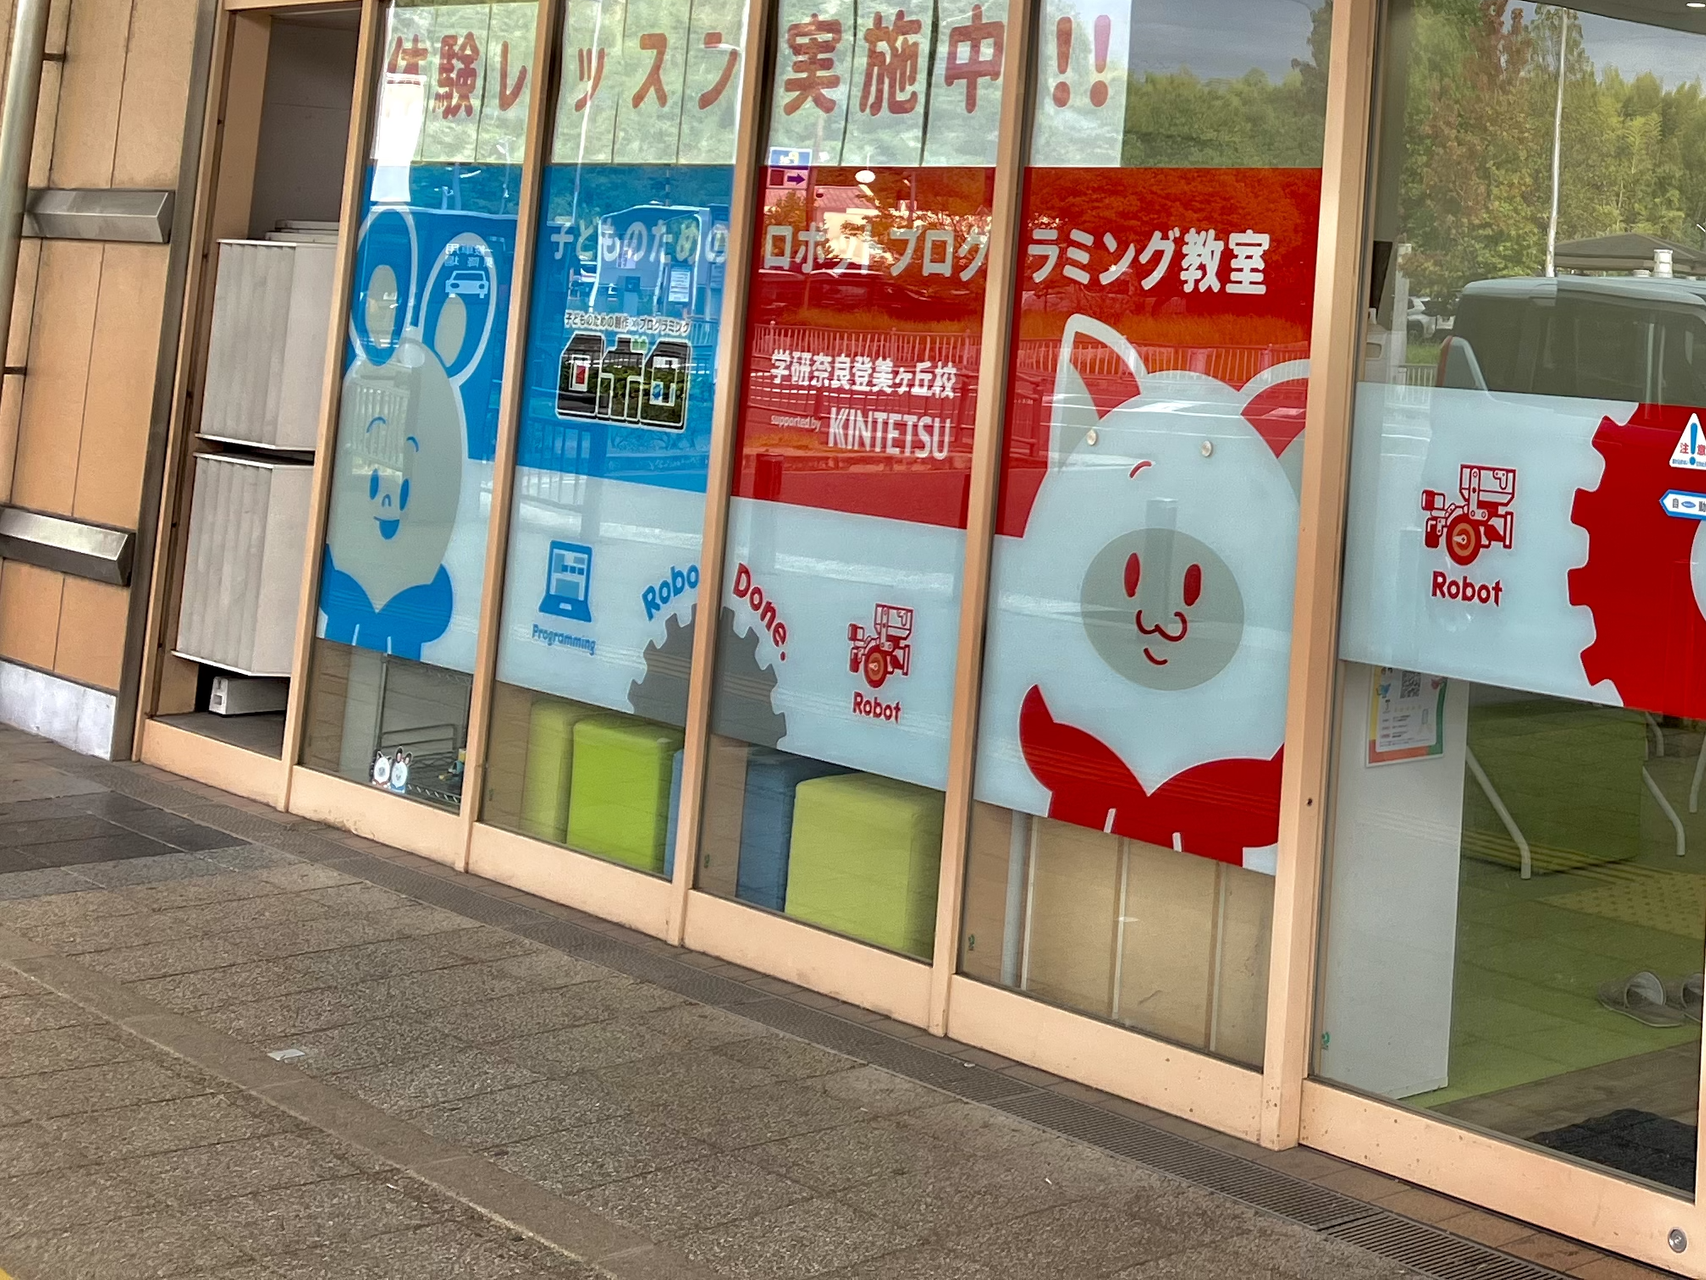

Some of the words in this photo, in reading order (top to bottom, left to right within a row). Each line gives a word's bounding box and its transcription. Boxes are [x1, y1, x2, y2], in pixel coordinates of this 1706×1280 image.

[551, 219, 728, 262] 子どものための
[564, 312, 629, 330] 子どものための制作
[639, 317, 691, 335] プログラミング
[770, 414, 809, 430] supported
[810, 417, 822, 433] by
[827, 407, 951, 460] KINTETSU
[1431, 570, 1503, 607] Robot
[641, 564, 699, 621] Robo
[732, 562, 788, 662] Done.
[531, 623, 596, 657] Programming
[852, 690, 901, 723] Robot
